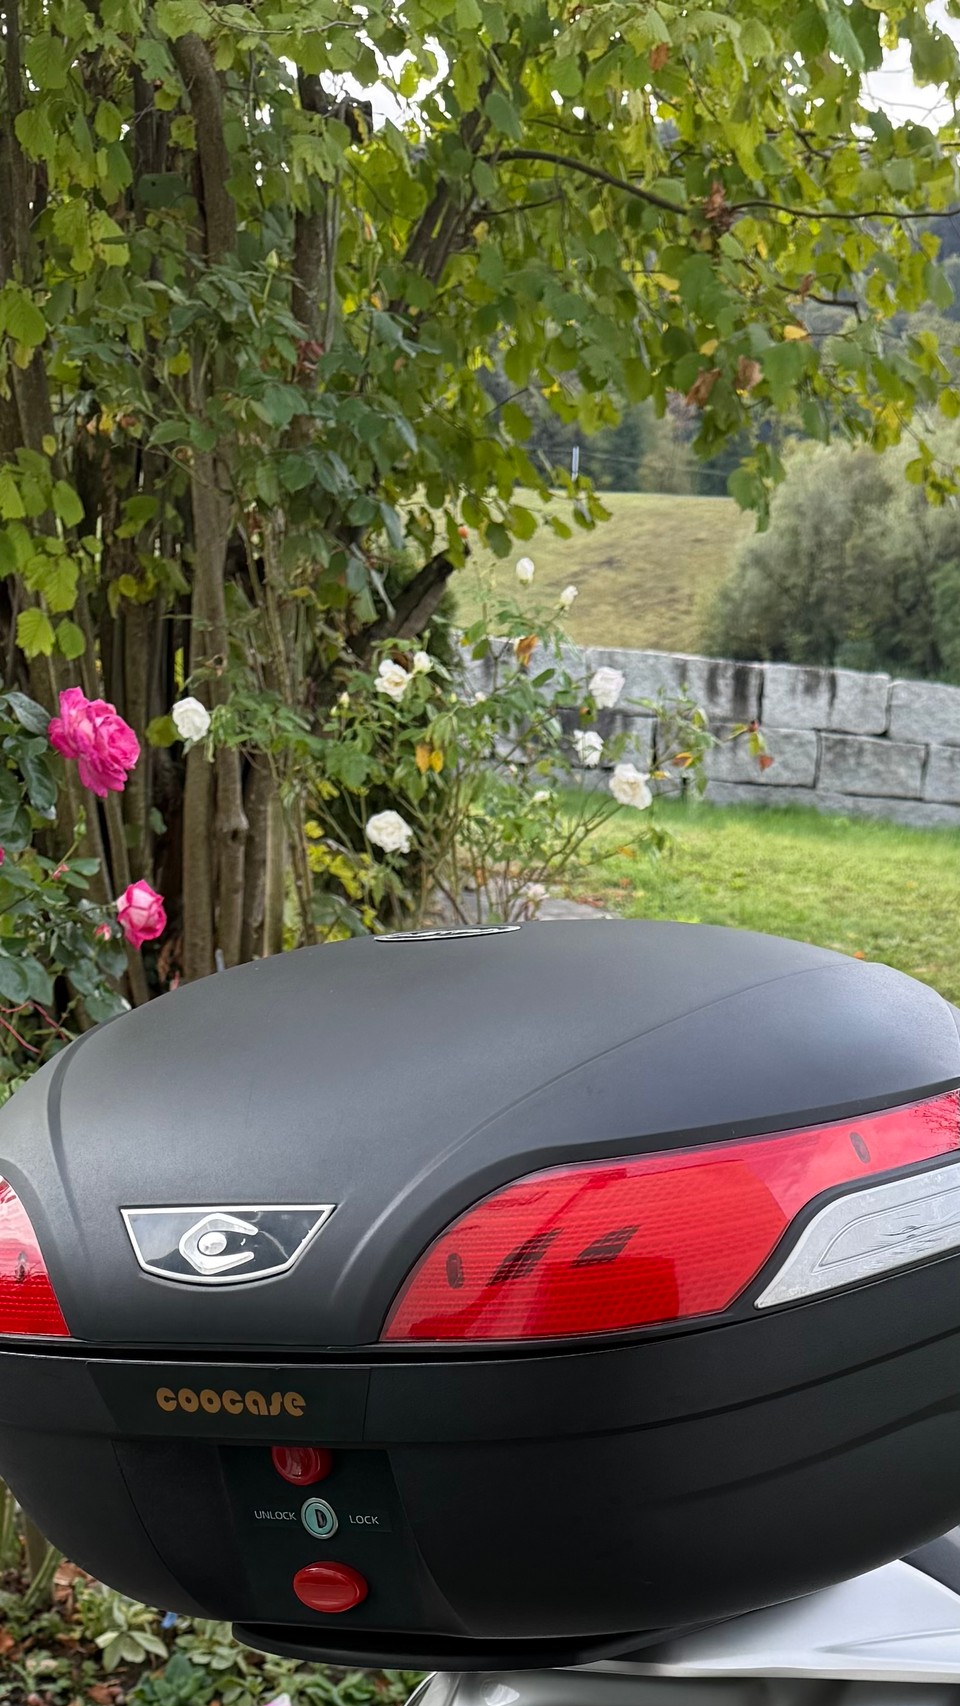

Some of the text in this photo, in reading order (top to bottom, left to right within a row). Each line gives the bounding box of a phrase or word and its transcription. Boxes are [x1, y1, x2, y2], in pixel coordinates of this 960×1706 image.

[156, 1387, 306, 1417] coocase
[254, 1510, 380, 1525] UNLOCK LOCK
